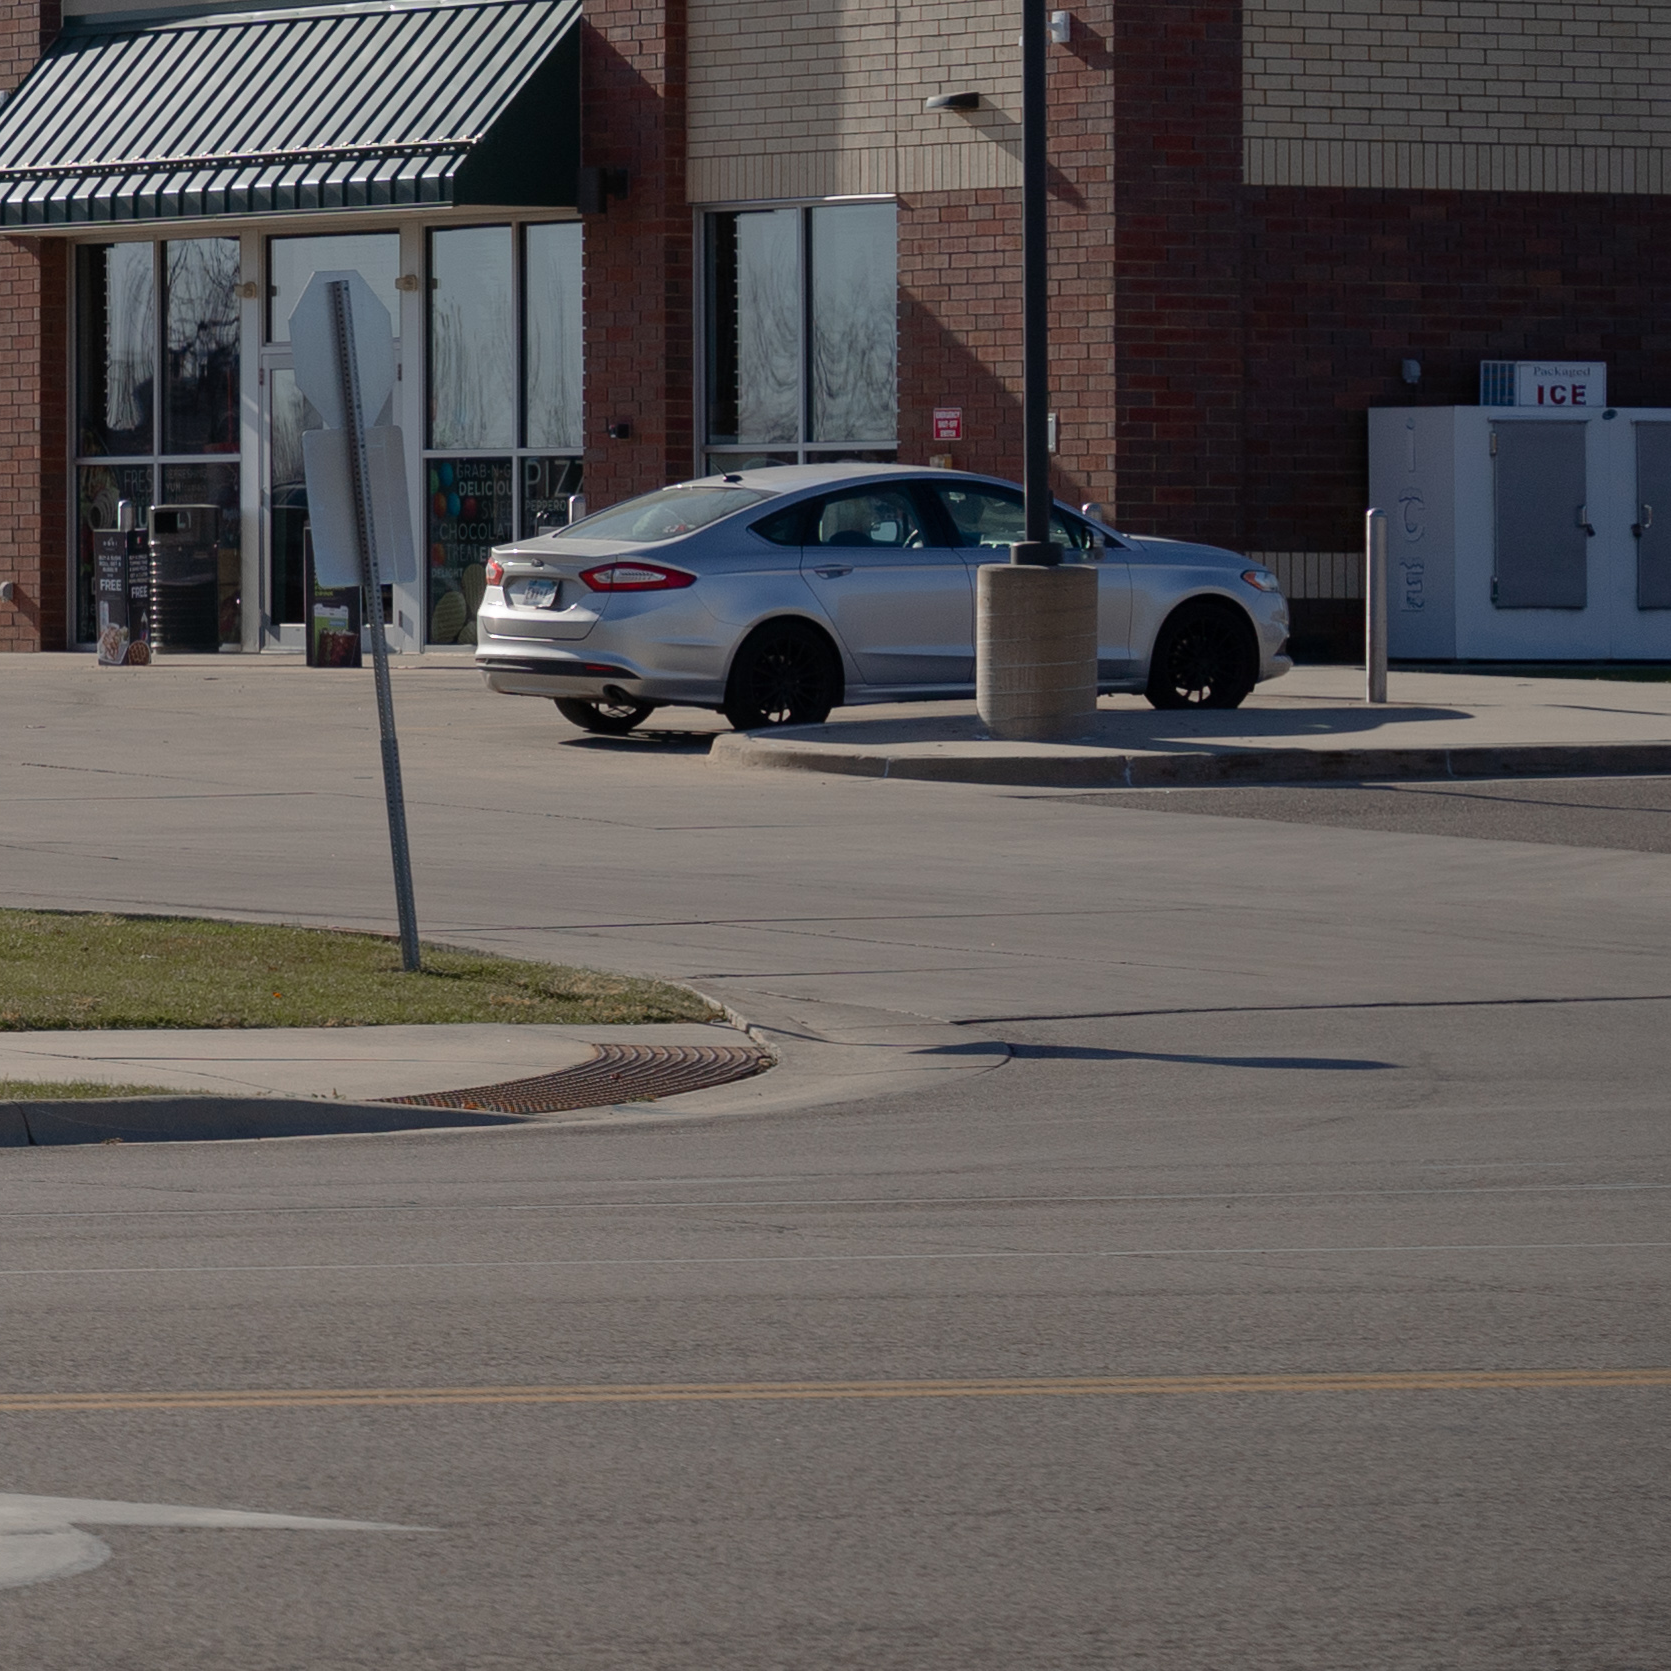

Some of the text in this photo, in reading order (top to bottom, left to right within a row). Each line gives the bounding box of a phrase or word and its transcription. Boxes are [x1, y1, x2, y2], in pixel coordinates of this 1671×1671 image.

[1534, 366, 1591, 377] Packaged
[1537, 384, 1586, 405] ICE
[100, 579, 122, 591] FREE
[131, 585, 148, 598] FREE
